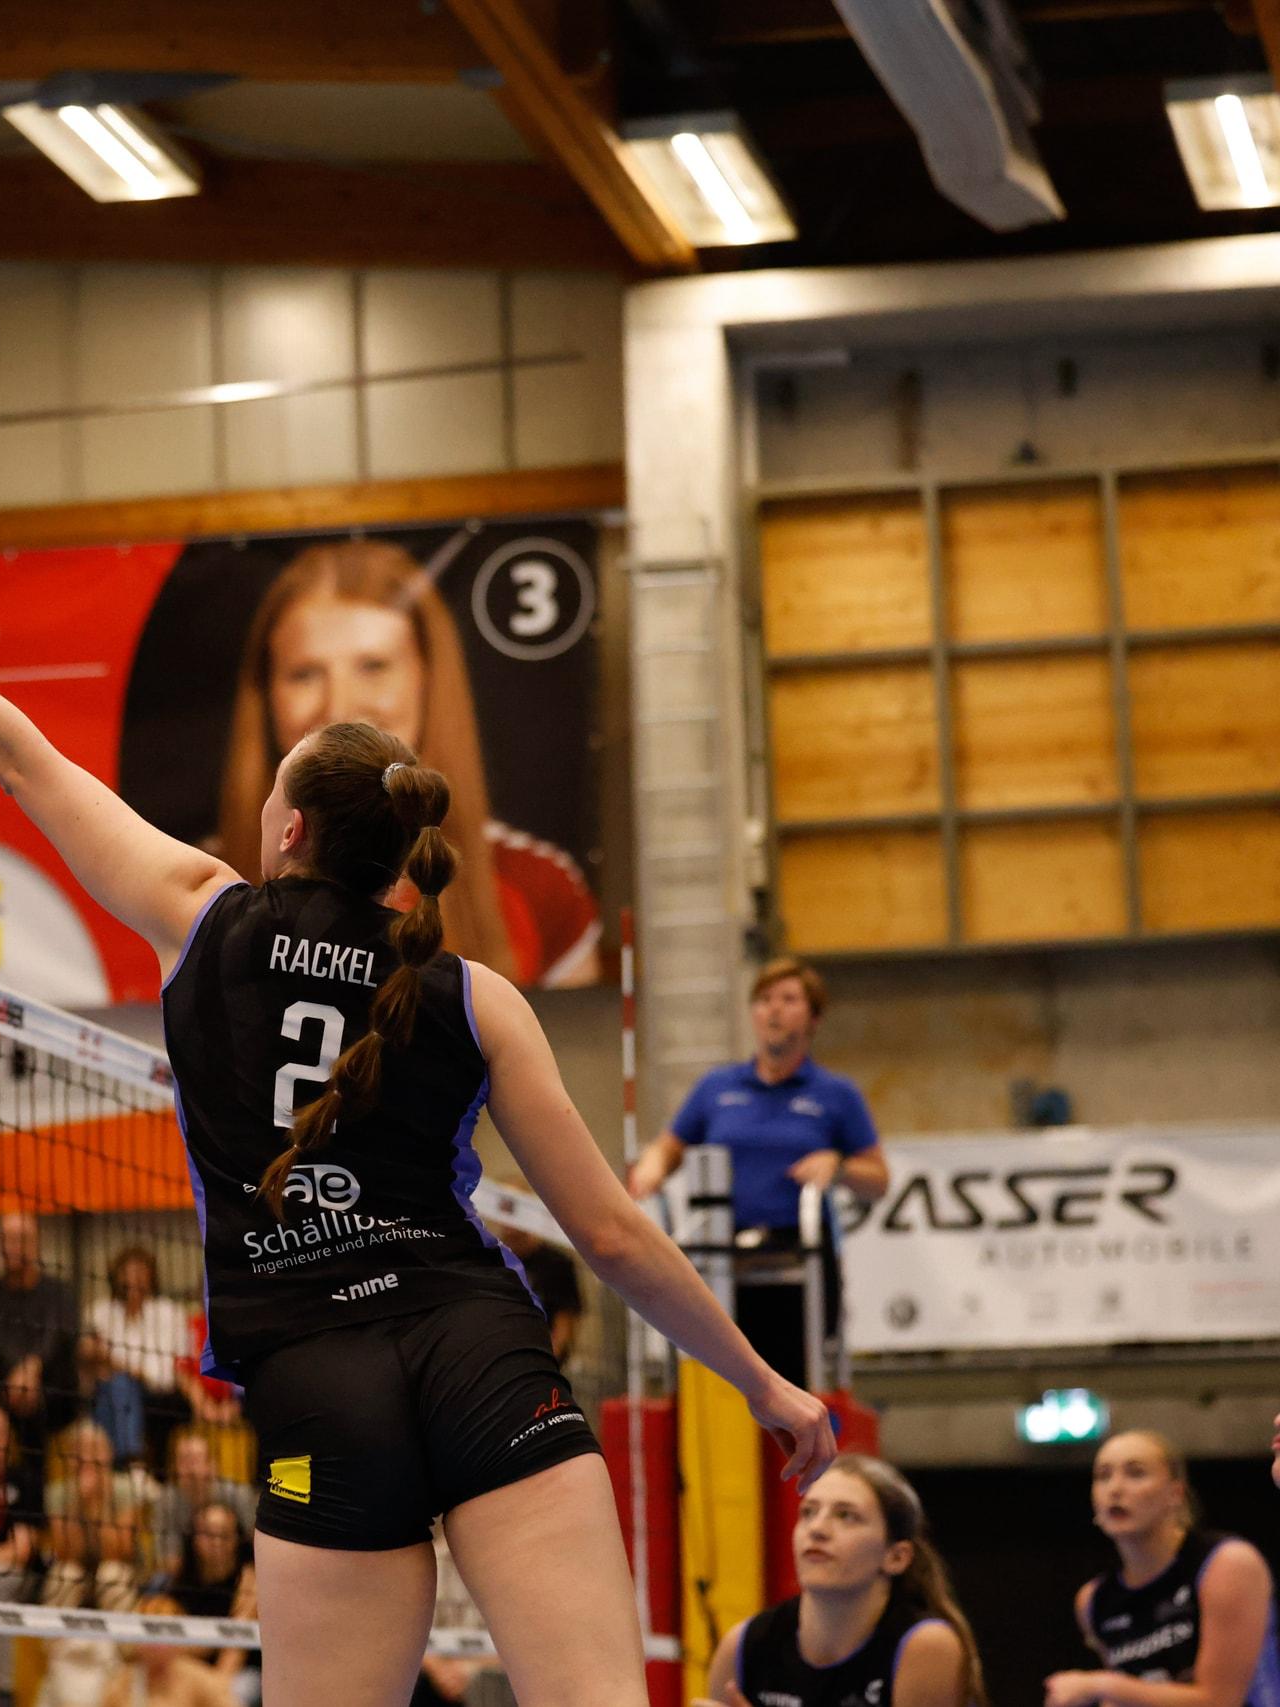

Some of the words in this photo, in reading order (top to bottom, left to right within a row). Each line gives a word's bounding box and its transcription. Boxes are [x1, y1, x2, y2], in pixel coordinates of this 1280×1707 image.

[509, 561, 559, 637] 3
[270, 934, 377, 988] RACKEL
[273, 1000, 345, 1134] 2
[243, 1210, 410, 1259] Schällib
[252, 1245, 332, 1274] Ingenieure
[336, 1236, 365, 1254] und
[369, 1226, 445, 1246] Architek
